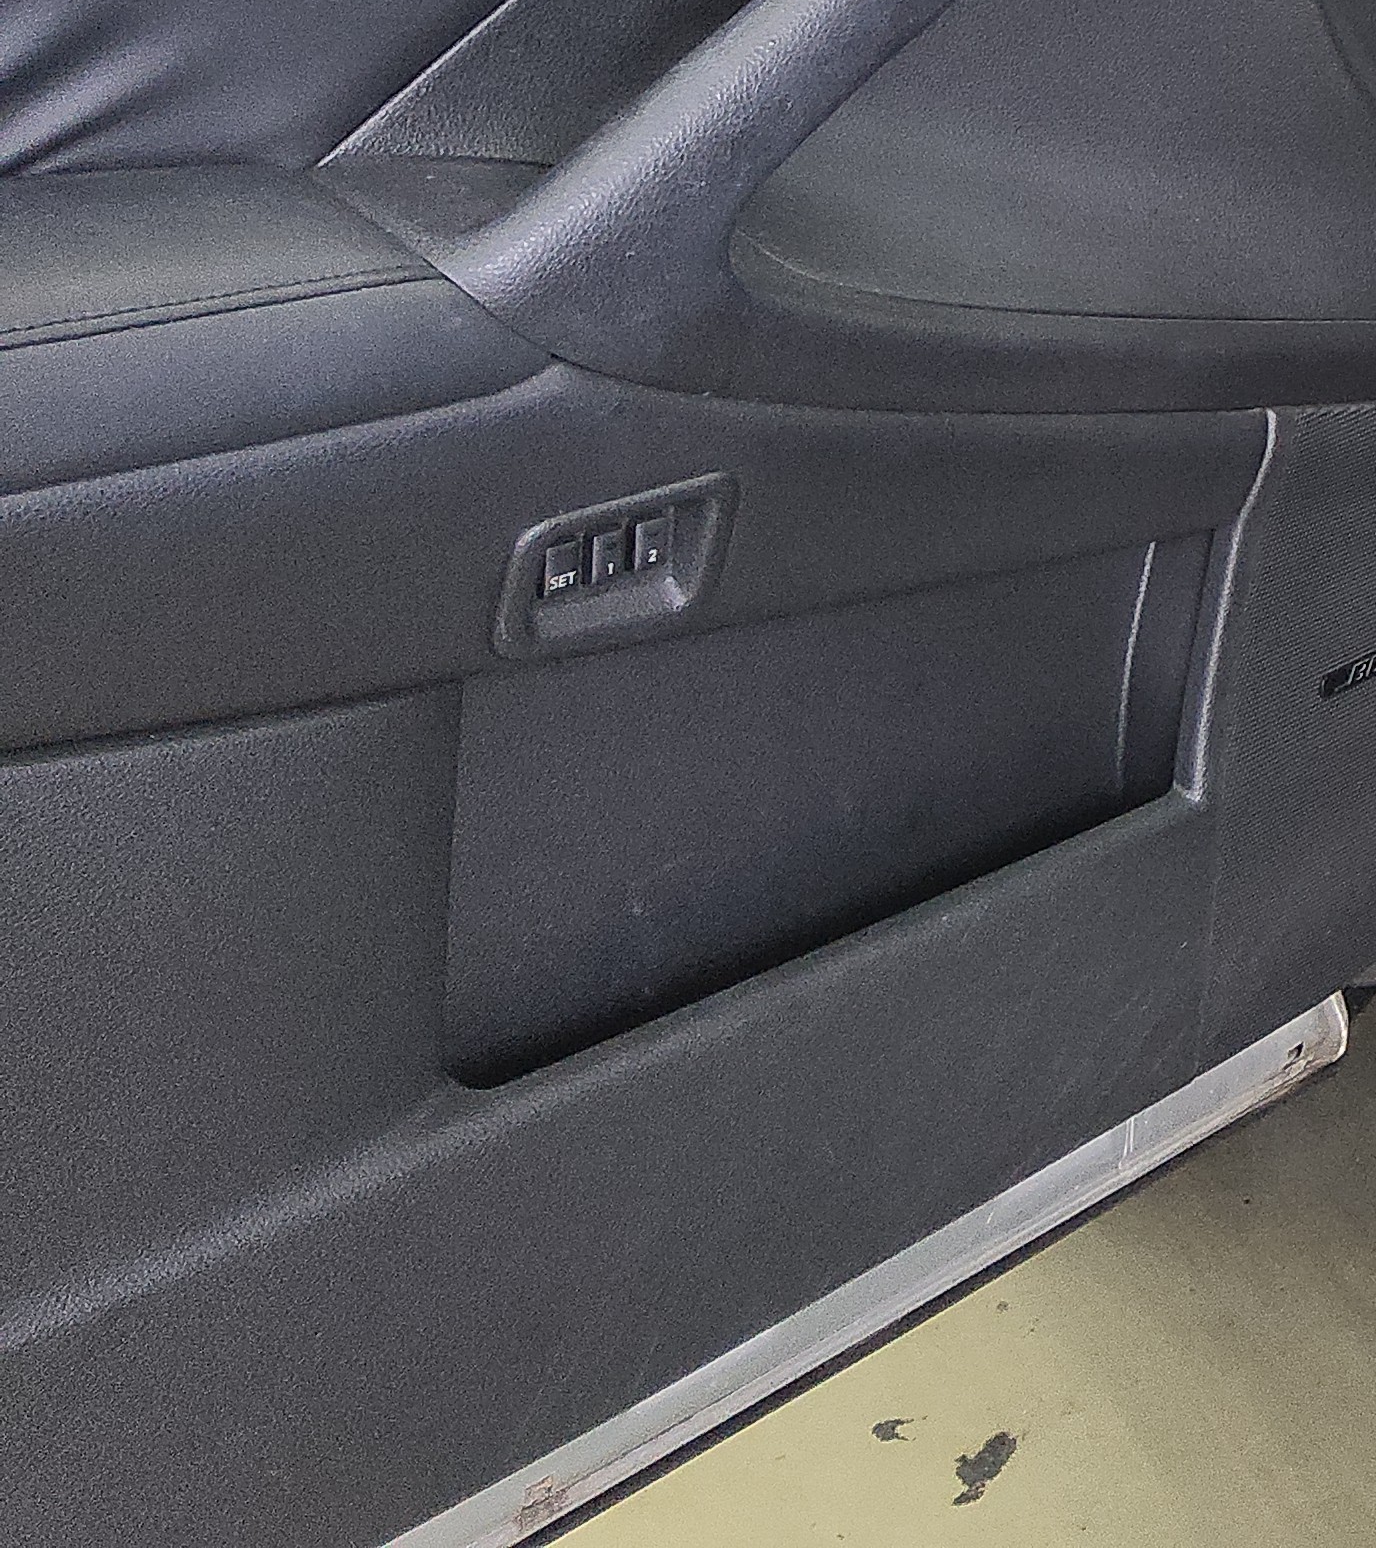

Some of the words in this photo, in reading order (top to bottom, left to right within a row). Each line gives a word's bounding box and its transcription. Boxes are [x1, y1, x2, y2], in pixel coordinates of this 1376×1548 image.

[549, 570, 577, 591] SET
[607, 562, 614, 576] 1
[647, 549, 658, 563] 2
